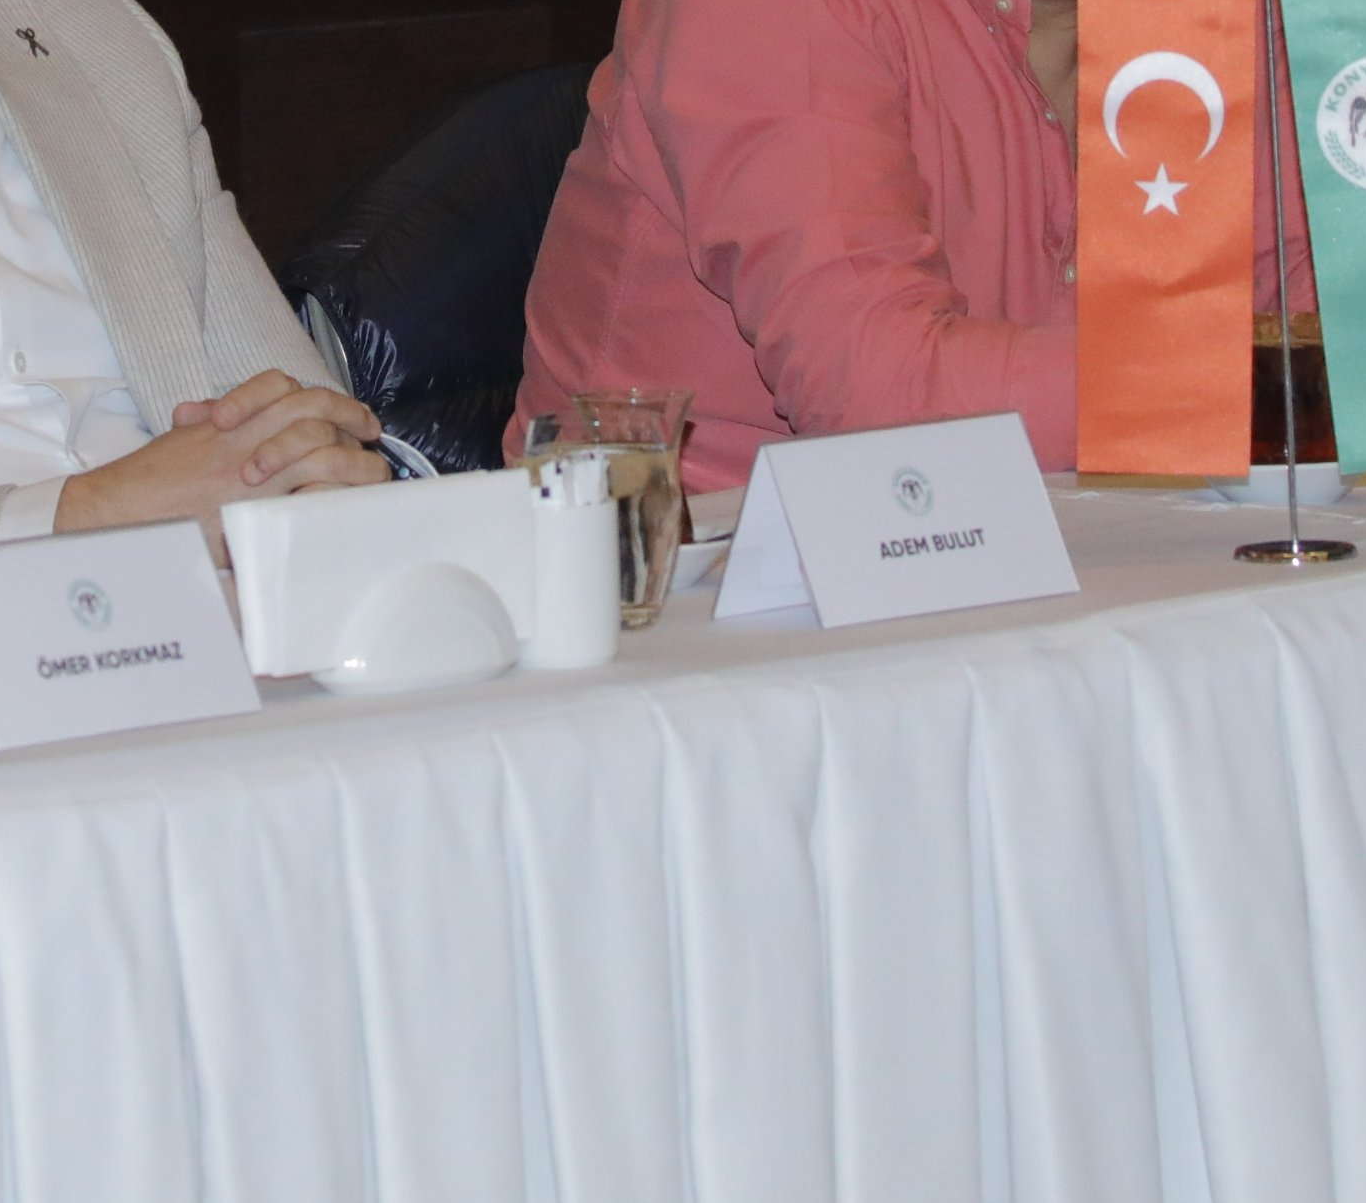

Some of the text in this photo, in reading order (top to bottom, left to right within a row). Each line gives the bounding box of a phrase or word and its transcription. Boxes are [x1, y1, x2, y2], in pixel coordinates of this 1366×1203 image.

[880, 528, 984, 559] ADEM BULUT
[37, 641, 184, 679] ÖMER KORKMAZ
